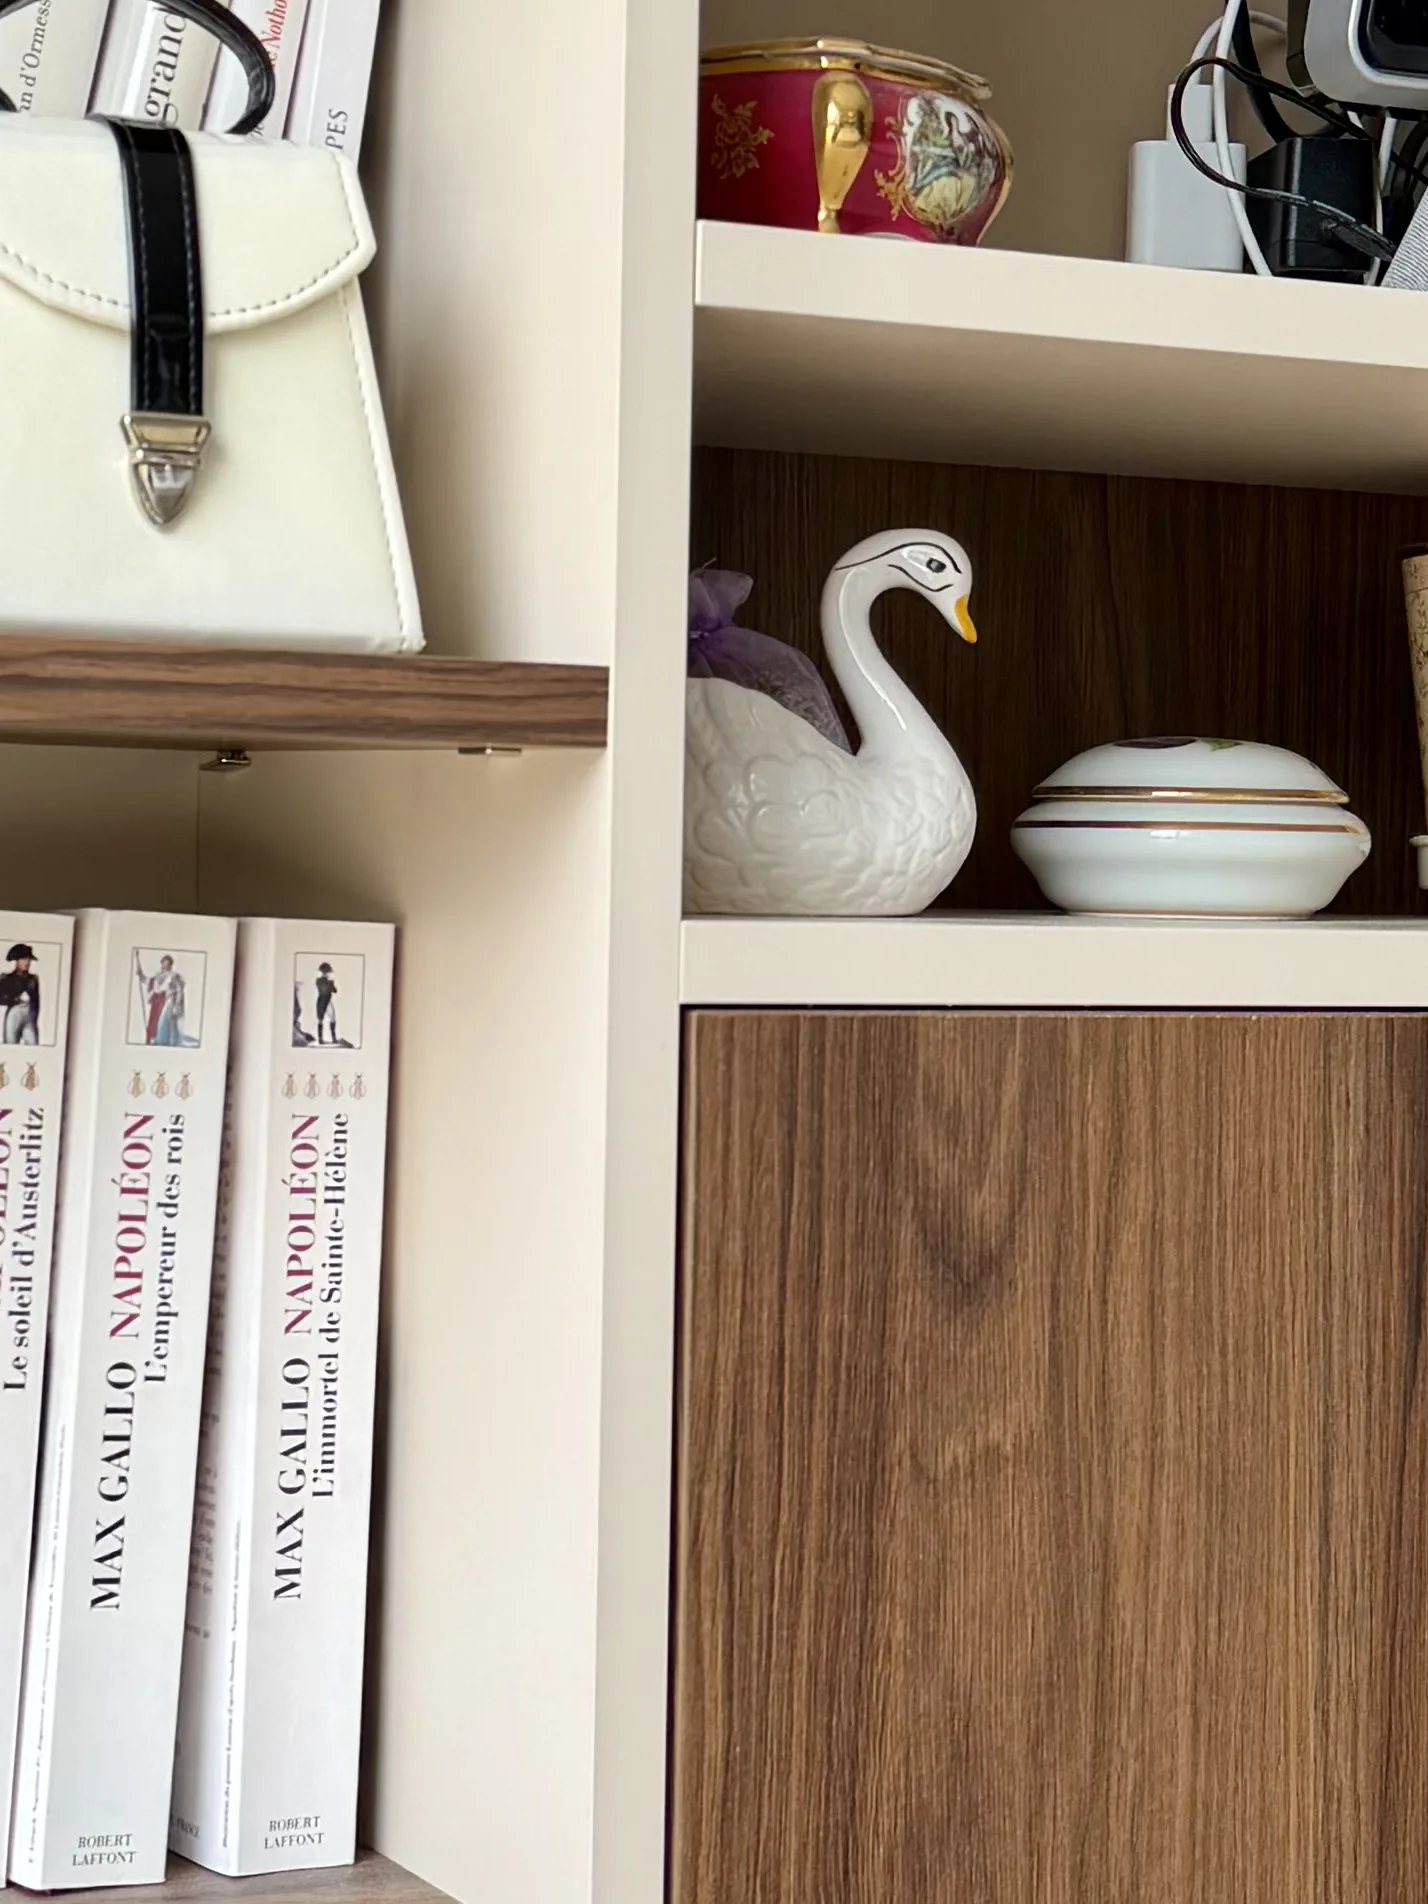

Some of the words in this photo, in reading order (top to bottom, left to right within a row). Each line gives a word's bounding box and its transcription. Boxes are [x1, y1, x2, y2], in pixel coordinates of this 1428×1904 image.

[161, 1114, 184, 1164] rois
[11, 1108, 44, 1266] d'Austerlitz
[109, 1112, 154, 1338] NAPOLÉON
[156, 1173, 180, 1218] des
[281, 1114, 319, 1334] NAPOLÉON
[319, 1113, 348, 1303] Sainte-Hélène
[7, 1276, 32, 1347] soleil
[144, 1226, 179, 1381] L'empereur
[318, 1312, 340, 1343] de
[3, 1356, 27, 1389] Le
[99, 1362, 135, 1502] GALLO
[278, 1358, 309, 1494] GALLO
[311, 1353, 338, 1497] L'immortel
[90, 1516, 125, 1608] MAX
[273, 1508, 303, 1598] MAX
[72, 1851, 136, 1866] LAFFONT
[78, 1834, 131, 1848] ROBERT
